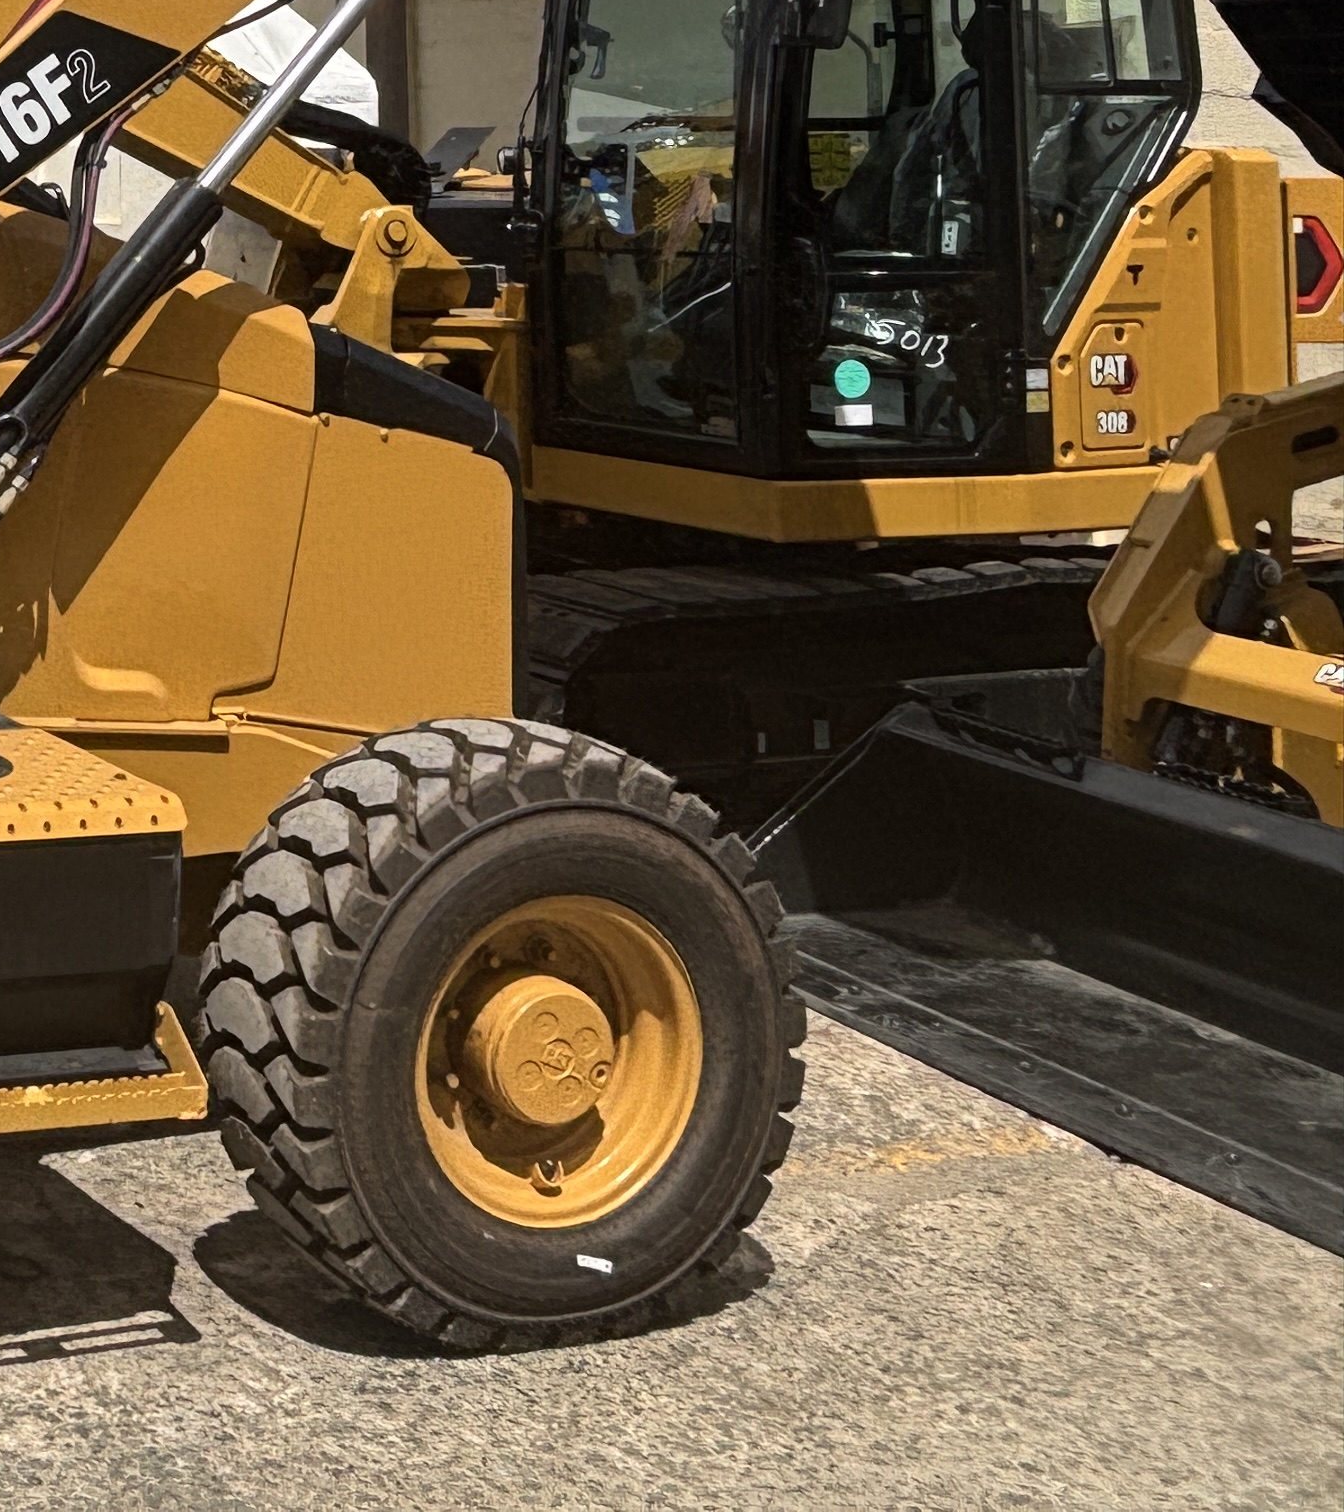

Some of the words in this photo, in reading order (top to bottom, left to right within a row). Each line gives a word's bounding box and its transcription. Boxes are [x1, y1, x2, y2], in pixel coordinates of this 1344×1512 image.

[1090, 355, 1128, 386] CAT
[1096, 410, 1129, 433] 308
[1313, 663, 1344, 688] CA
